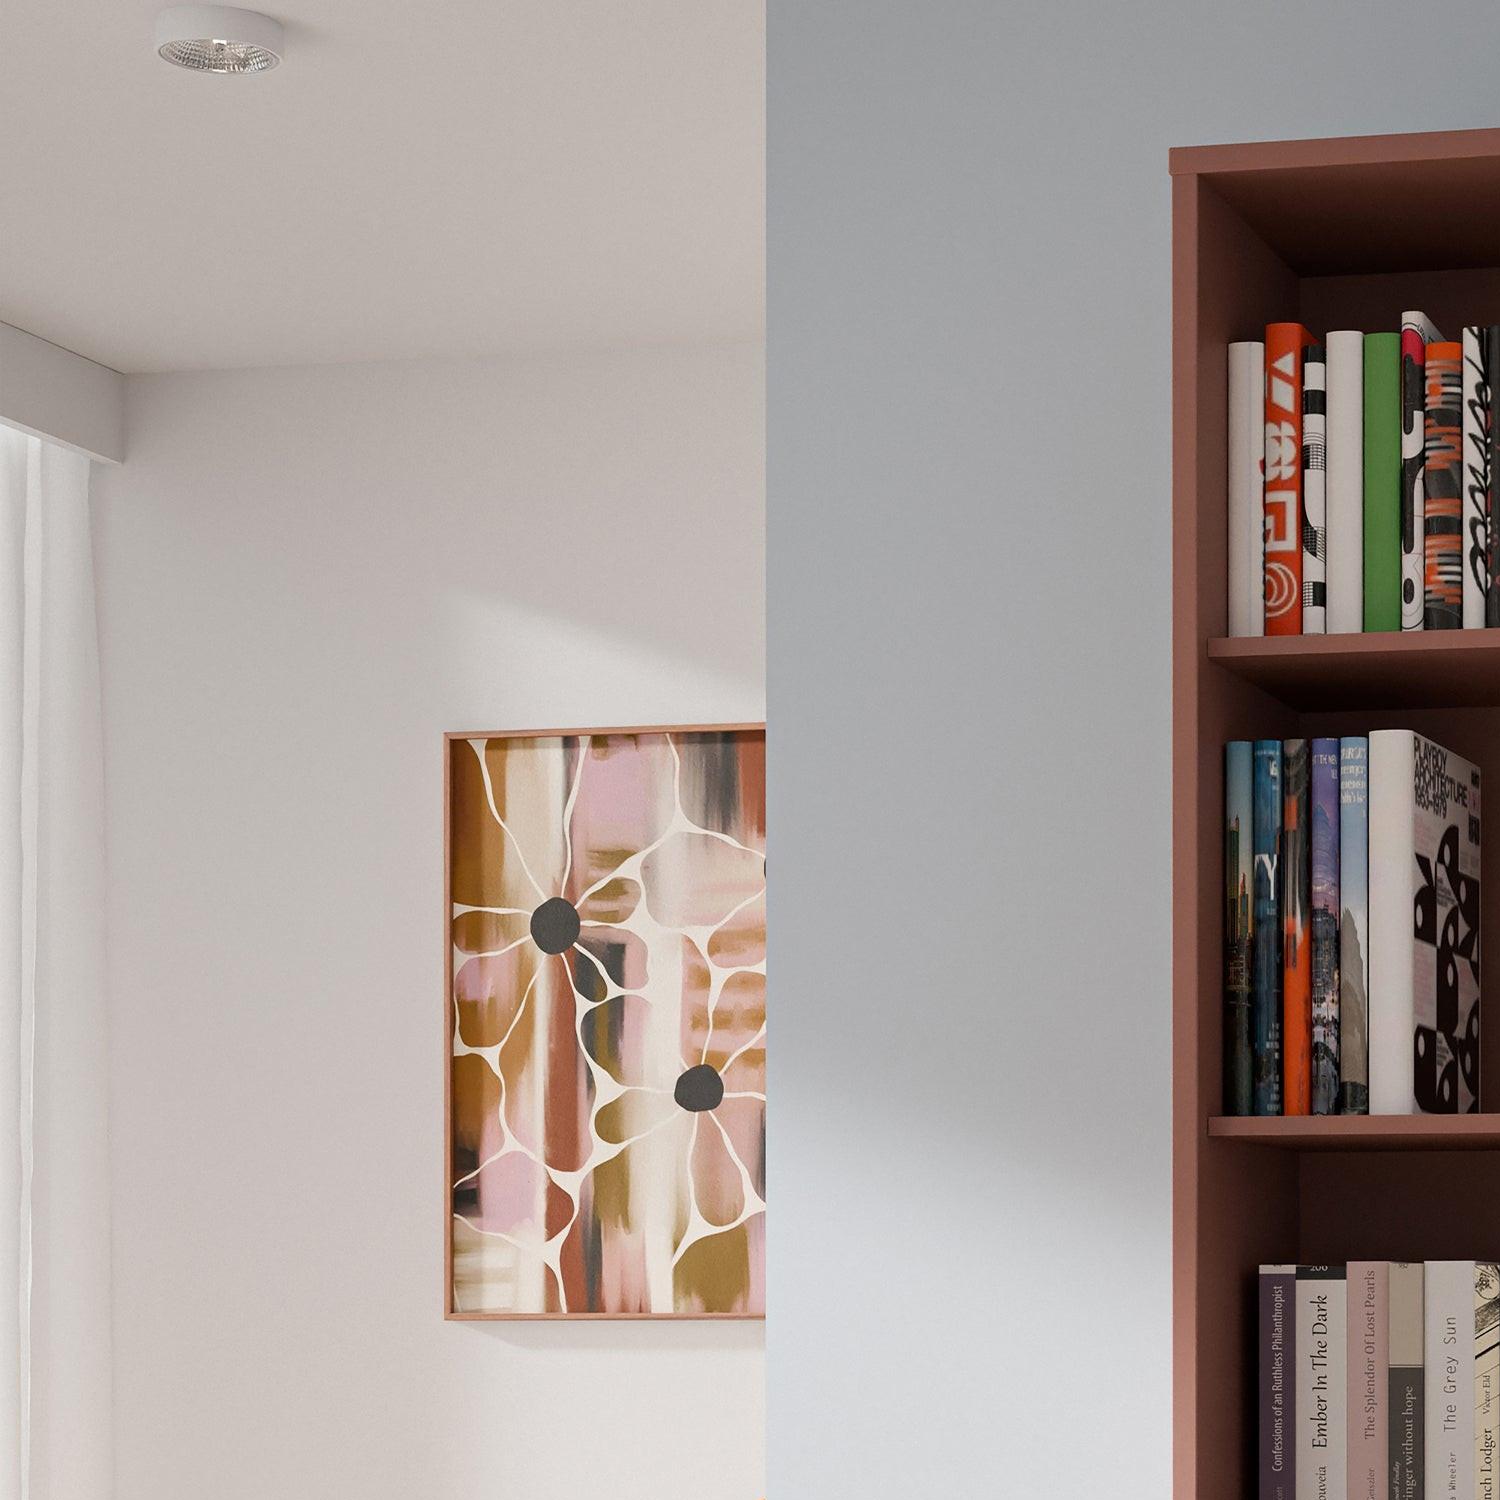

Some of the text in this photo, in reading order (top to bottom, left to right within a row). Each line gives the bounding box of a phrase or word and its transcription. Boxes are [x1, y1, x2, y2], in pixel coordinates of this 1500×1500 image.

[1271, 1286, 1286, 1471] Confessions of an Ruthless Philanthropist
[1309, 1296, 1328, 1447] Ember In The Dark
[1363, 1271, 1378, 1439] The Splendor Of Lost Pearls
[1442, 1318, 1459, 1431] The Grey Sun
[1447, 1453, 1457, 1490] Wheeler
